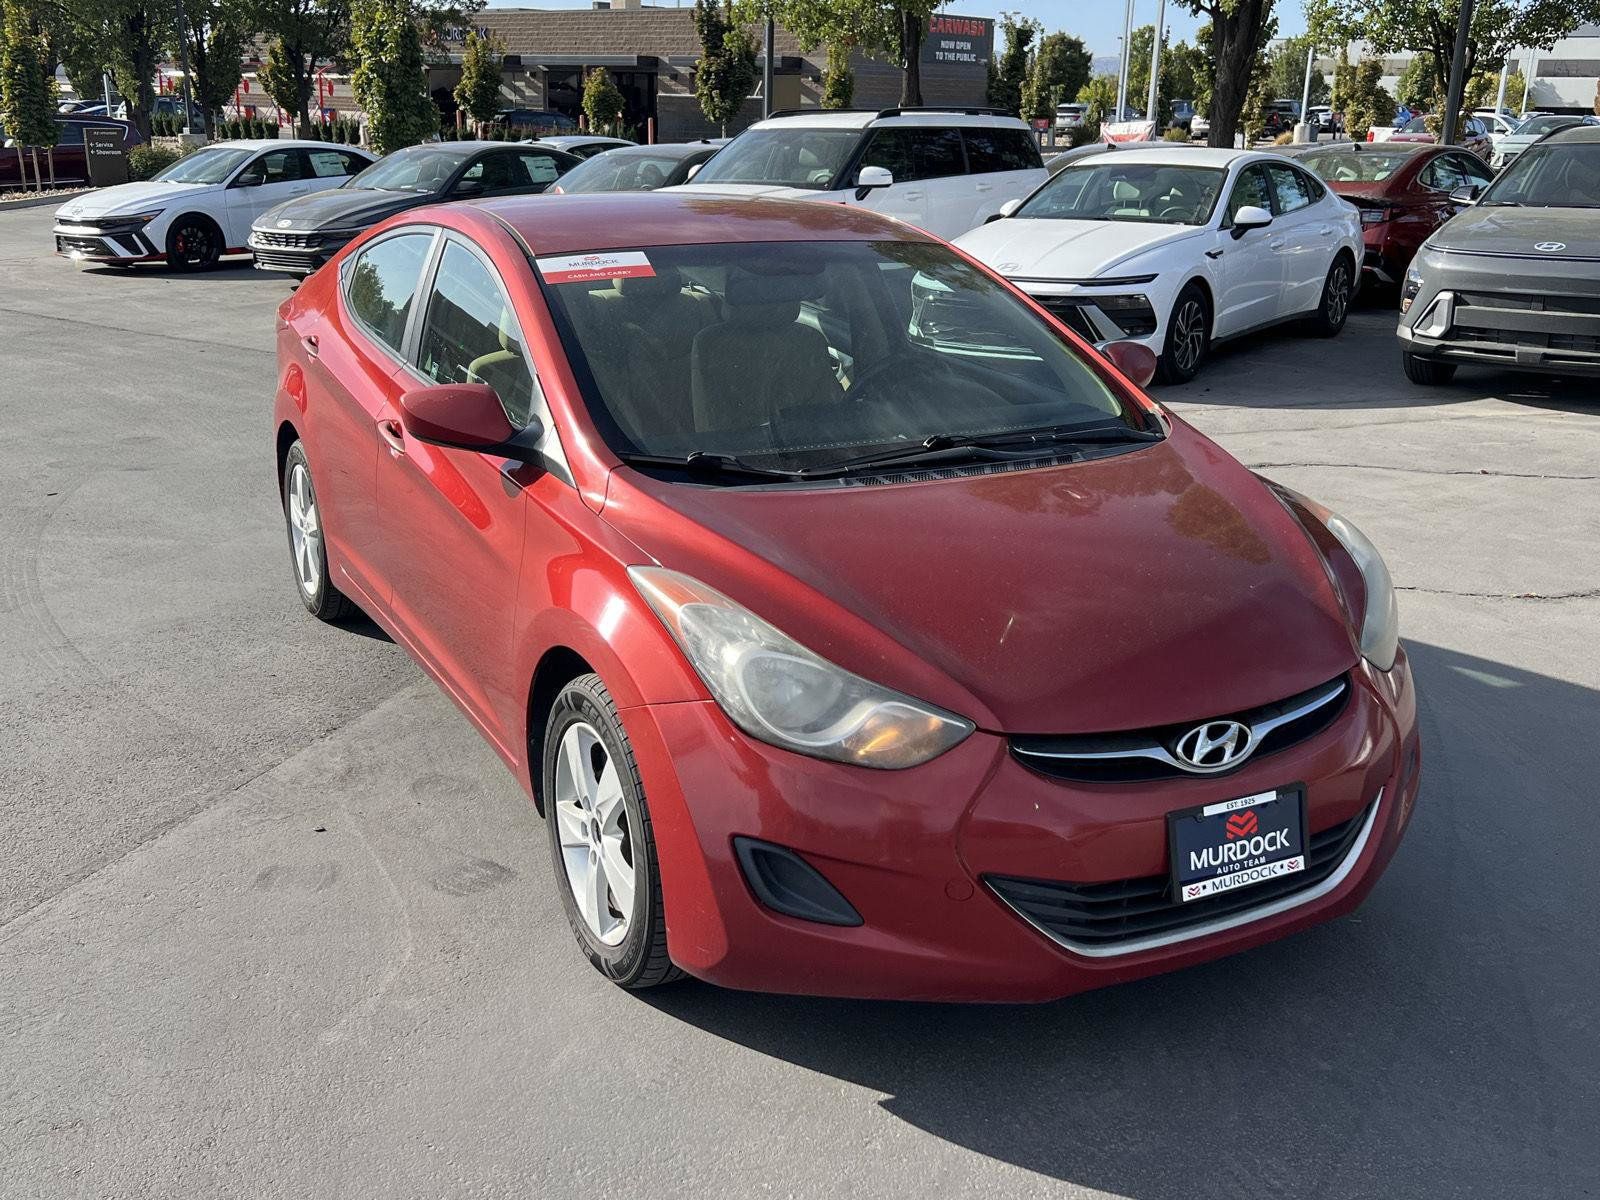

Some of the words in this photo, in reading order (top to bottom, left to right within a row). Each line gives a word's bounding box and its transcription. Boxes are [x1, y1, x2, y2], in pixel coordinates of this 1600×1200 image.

[929, 16, 985, 36] CARWASH
[941, 40, 955, 49] NOW
[956, 40, 971, 50] OPEN
[936, 51, 943, 60] TO
[944, 52, 955, 61] THE
[956, 53, 976, 62] PUBLIC
[568, 259, 620, 268] MURDOCK
[1240, 798, 1256, 807] 1925
[1190, 828, 1290, 871] MURDOCK
[1216, 863, 1240, 875] AUTO
[1243, 856, 1266, 868] TEAM
[1211, 865, 1278, 892] MURDOCK
